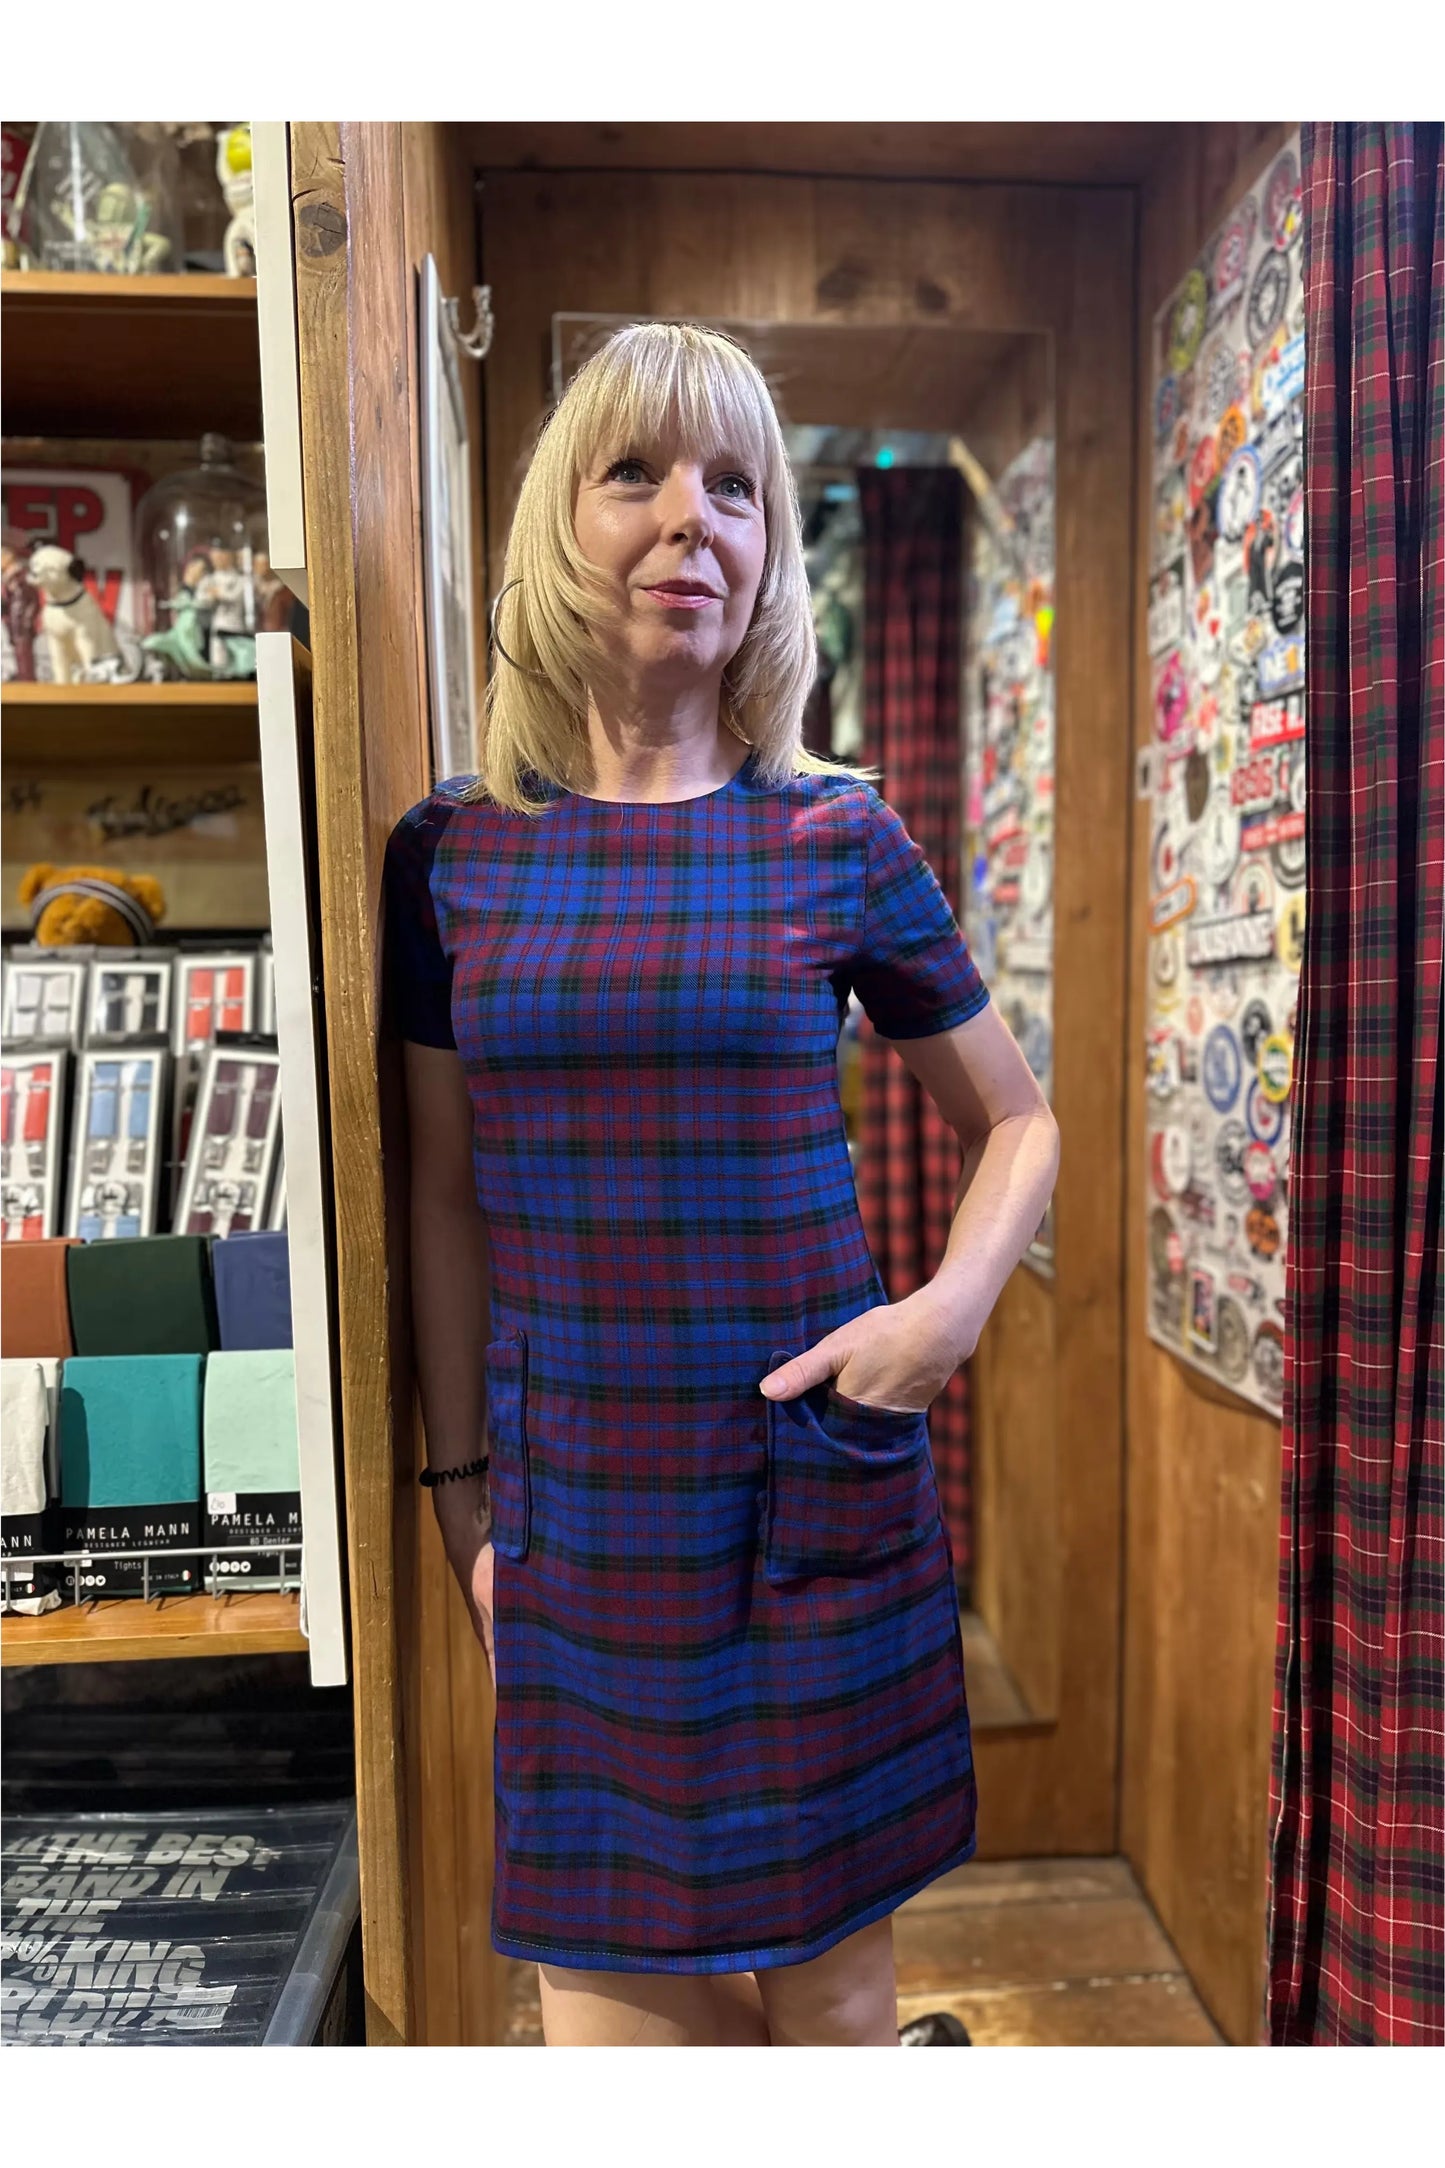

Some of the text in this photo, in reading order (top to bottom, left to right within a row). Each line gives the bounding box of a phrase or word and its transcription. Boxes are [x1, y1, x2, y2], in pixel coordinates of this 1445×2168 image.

[211, 1512, 275, 1526] PAMELA
[66, 1522, 190, 1540] PAMELA MANN
[84, 1541, 126, 1549] DESIGNER
[114, 1561, 142, 1571] Tights
[2, 1865, 232, 1902] BAND IN
[5, 1898, 122, 1933] THE
